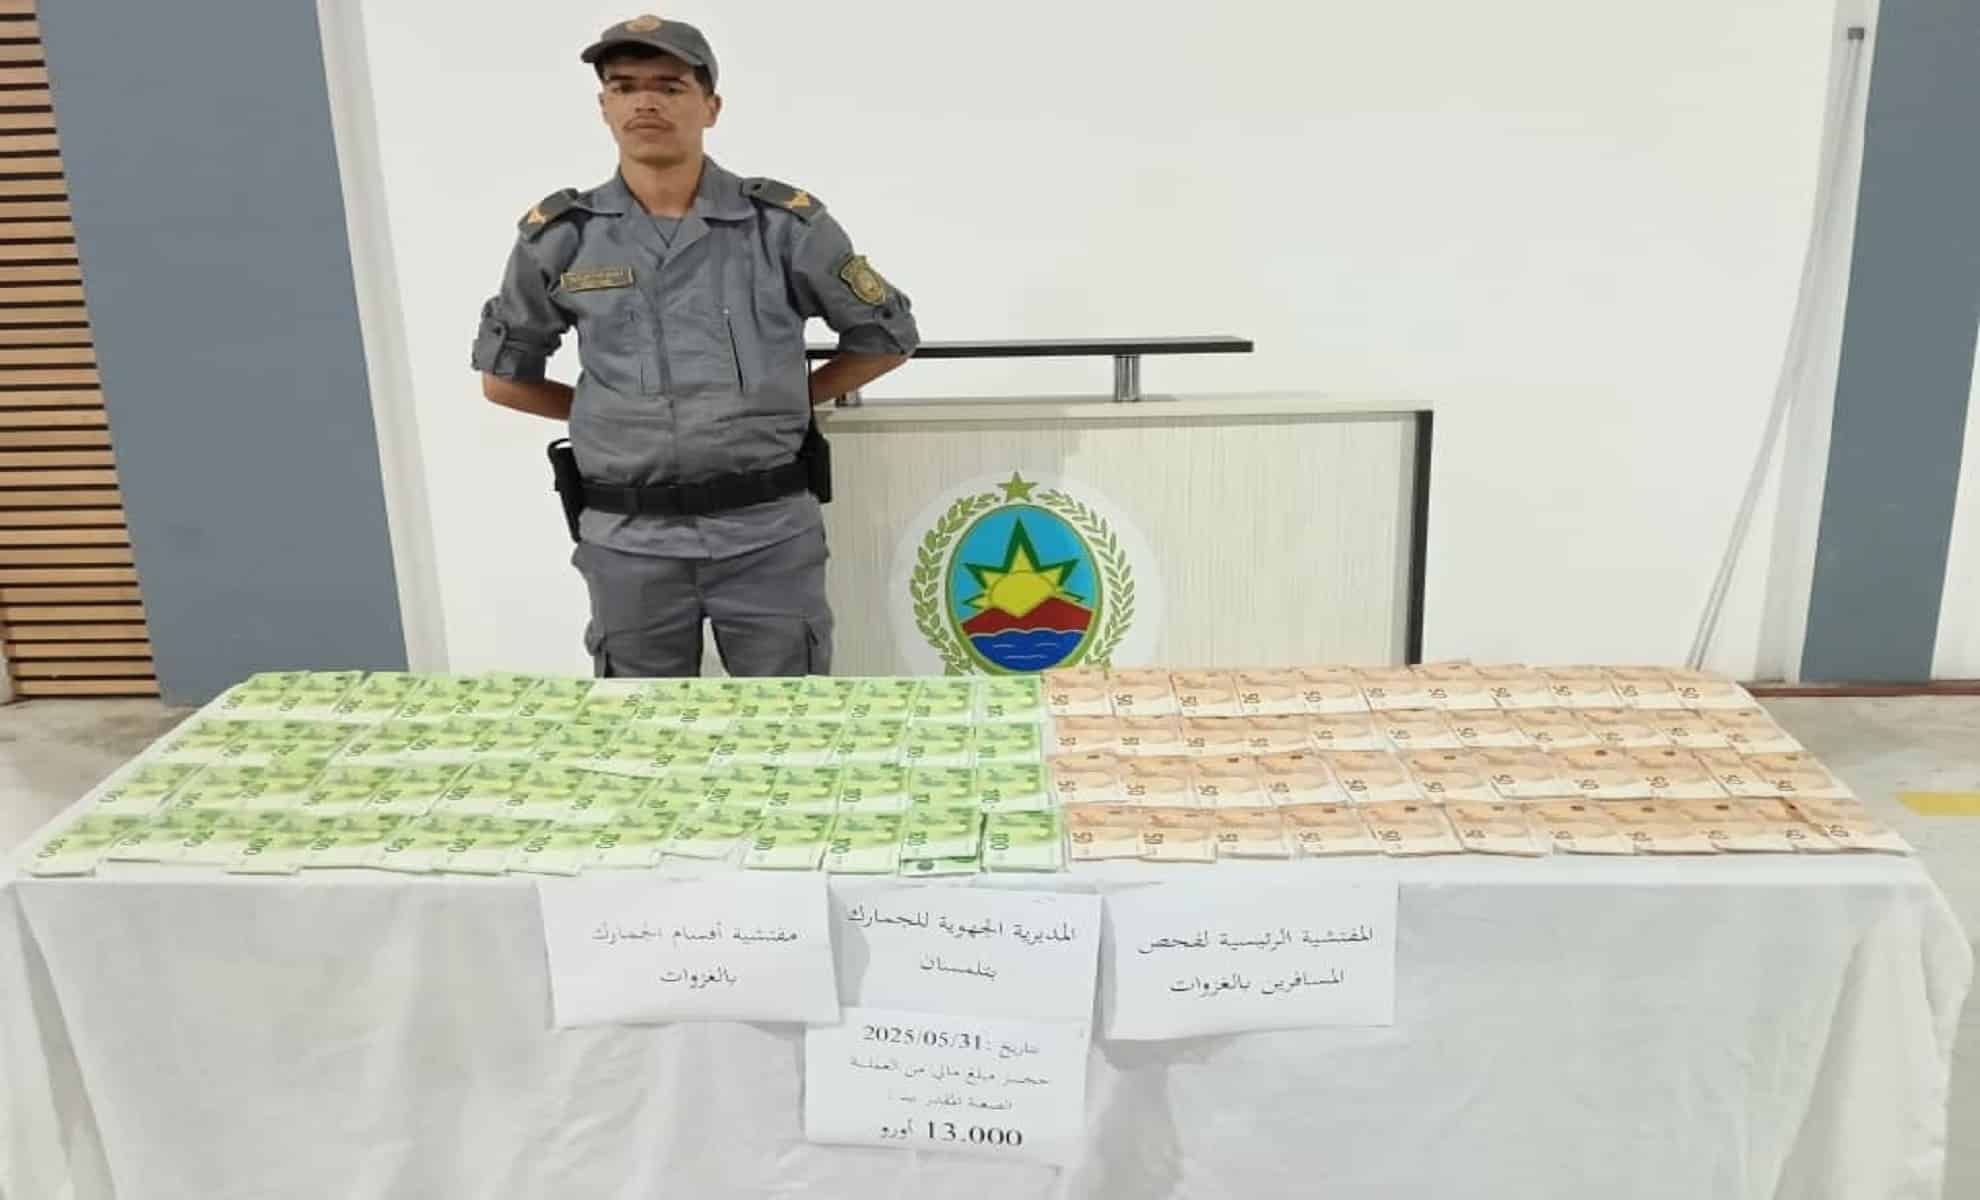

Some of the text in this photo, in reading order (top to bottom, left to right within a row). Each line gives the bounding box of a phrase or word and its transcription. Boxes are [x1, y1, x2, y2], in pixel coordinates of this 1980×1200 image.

[592, 920, 798, 949] مفتشية أقسام الجمارك
[847, 905, 1075, 946] المديرية الجهوية للجمارك
[1136, 924, 1373, 954] المفتشية الرئيسية لفحص
[659, 965, 737, 989] بالغزوات
[920, 956, 998, 982] بتلمسان
[1169, 968, 1344, 998] المسافرين بالغزوات
[903, 1067, 925, 1080] من
[879, 1116, 1023, 1146] 13.000 أورو
